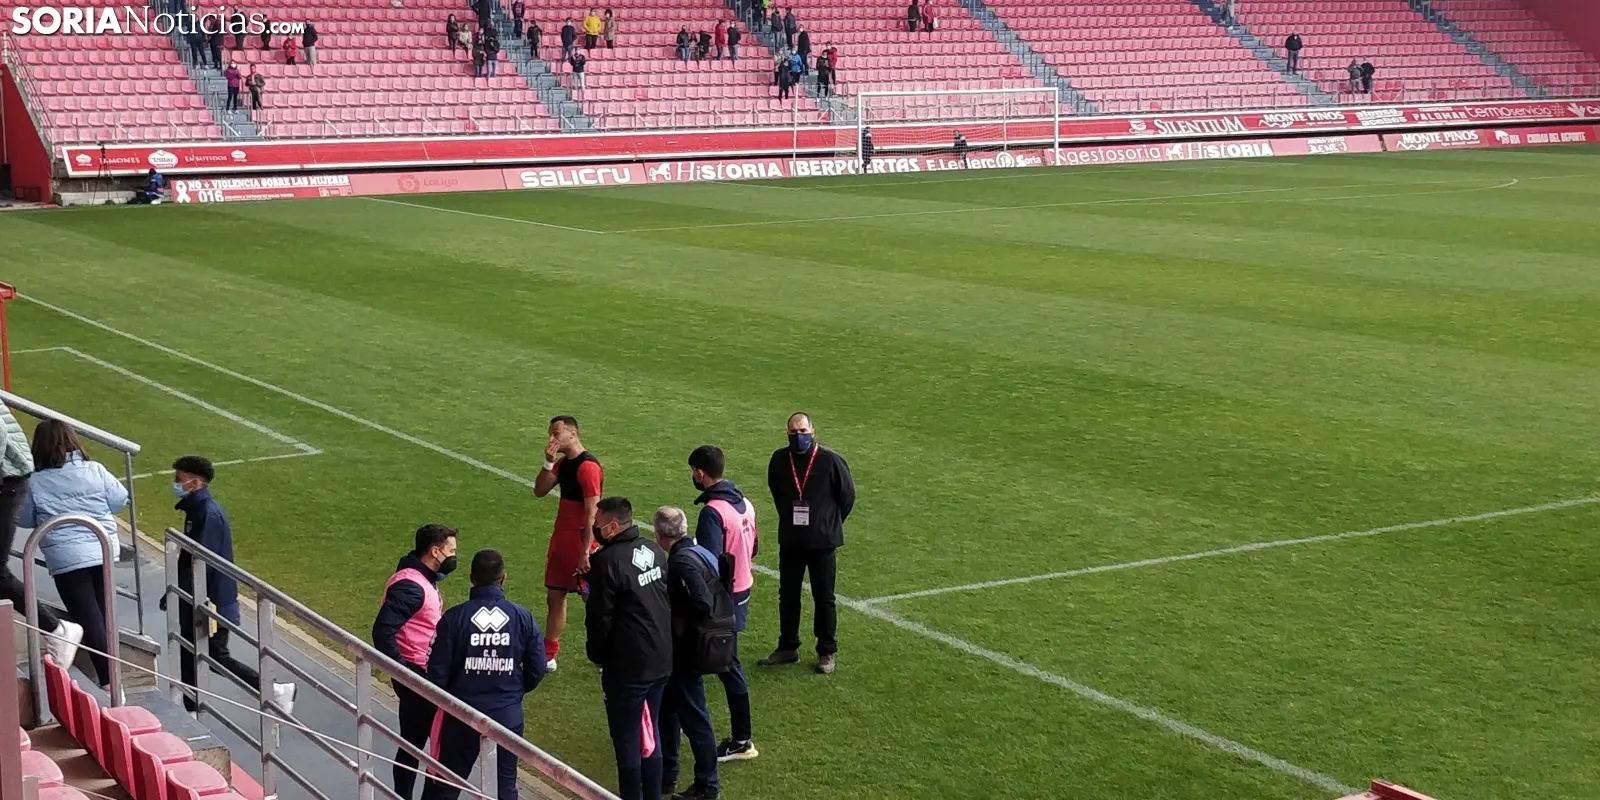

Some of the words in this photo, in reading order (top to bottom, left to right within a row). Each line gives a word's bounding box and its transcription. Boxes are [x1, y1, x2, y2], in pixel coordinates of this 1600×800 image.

[1263, 111, 1308, 124] MONTE
[1308, 111, 1346, 122] PINOS
[1411, 110, 1468, 121] PALOMAR
[1153, 116, 1248, 135] SILENTIUM
[1400, 131, 1442, 144] MONTE
[1442, 130, 1480, 142] PINOS
[187, 181, 202, 190] NO
[213, 178, 261, 190] VIOLENCIA
[260, 177, 290, 188] SOBRE
[291, 176, 308, 187] LAS
[308, 174, 350, 187] MUJERES
[198, 190, 225, 203] 016
[637, 565, 662, 587] errea
[470, 632, 511, 647] errea
[464, 656, 514, 672] NUMANCIA
